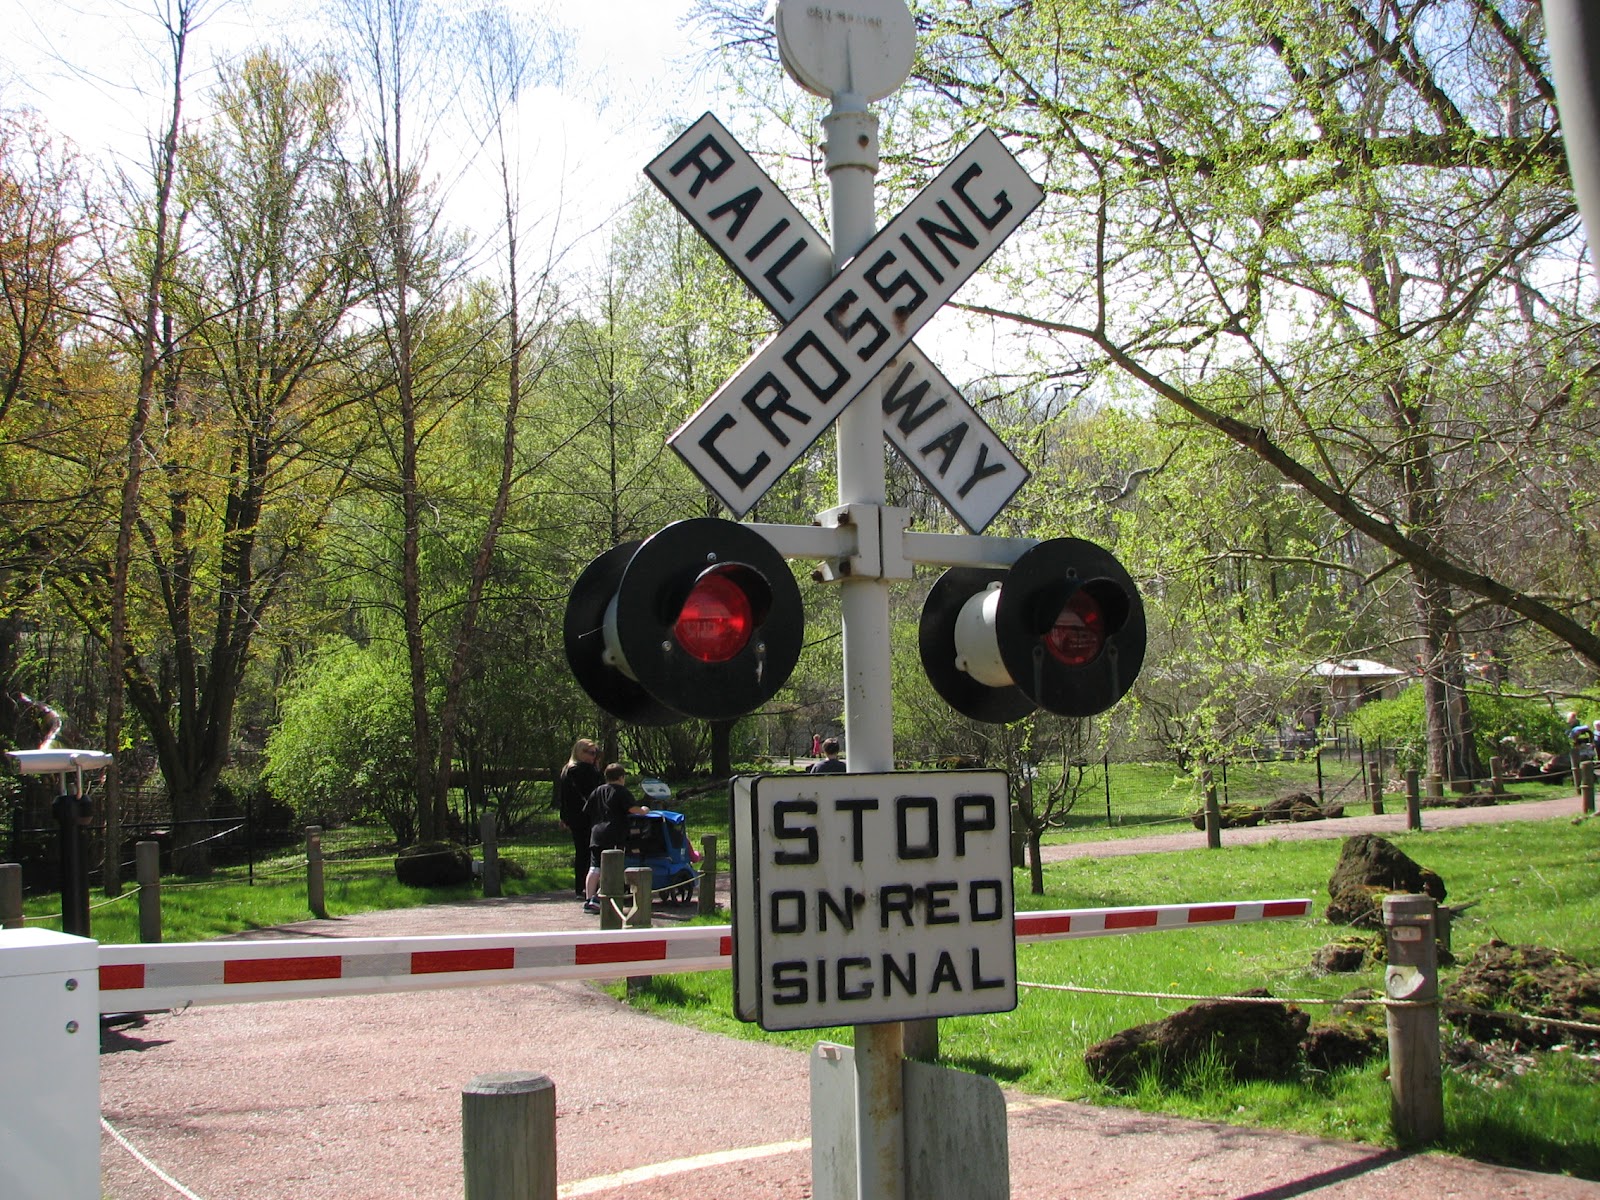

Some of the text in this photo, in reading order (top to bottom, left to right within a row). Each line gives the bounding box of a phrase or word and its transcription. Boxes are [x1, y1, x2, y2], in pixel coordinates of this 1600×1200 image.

[669, 134, 1006, 498] RAIL WAY
[698, 163, 1013, 490] CROSSING
[773, 795, 996, 866] STOP
[770, 879, 1004, 934] ON RED
[771, 947, 1006, 1006] SIGNAL
